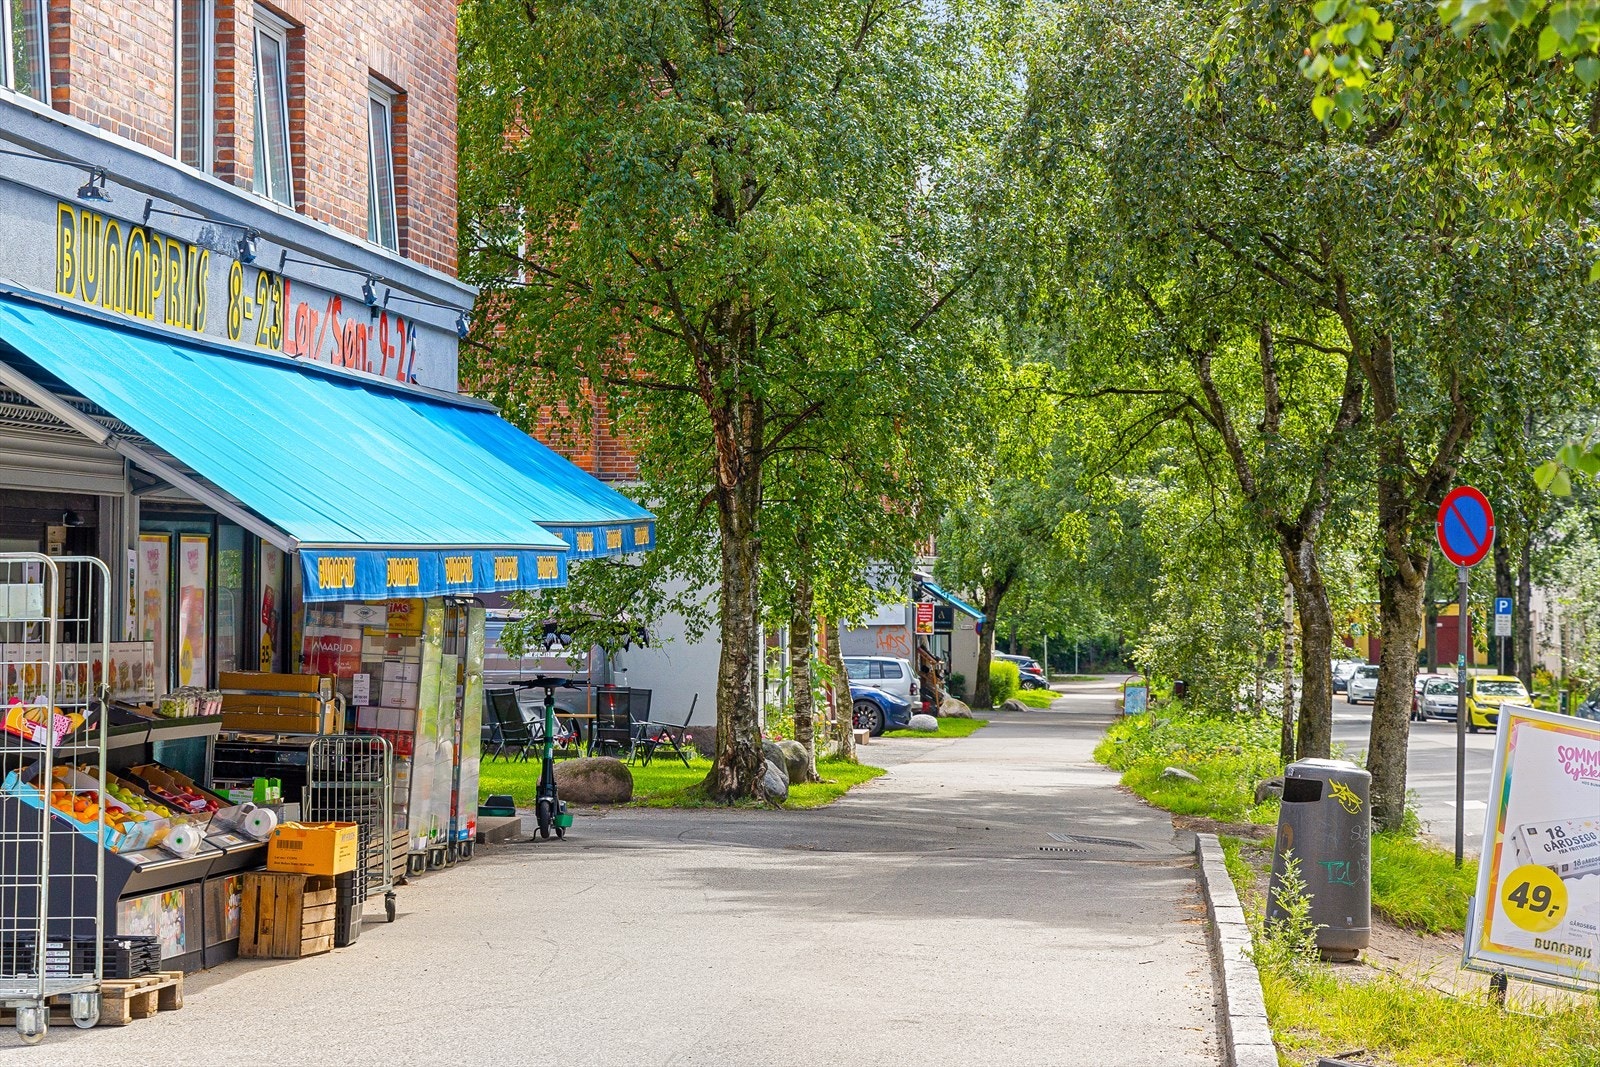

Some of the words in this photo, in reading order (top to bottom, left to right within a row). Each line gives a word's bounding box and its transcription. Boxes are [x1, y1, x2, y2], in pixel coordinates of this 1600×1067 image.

[56, 202, 210, 333] BUNNPRIS
[228, 259, 284, 350] 8-23
[318, 557, 355, 589] BUNNPRIS
[1499, 600, 1509, 613] P
[312, 641, 353, 653] MAARUD
[1543, 832, 1598, 853] GÅRDSEGG
[1545, 825, 1566, 840] 18
[1508, 881, 1560, 918] 49,-
[1534, 938, 1593, 959] BUNNPRIS
